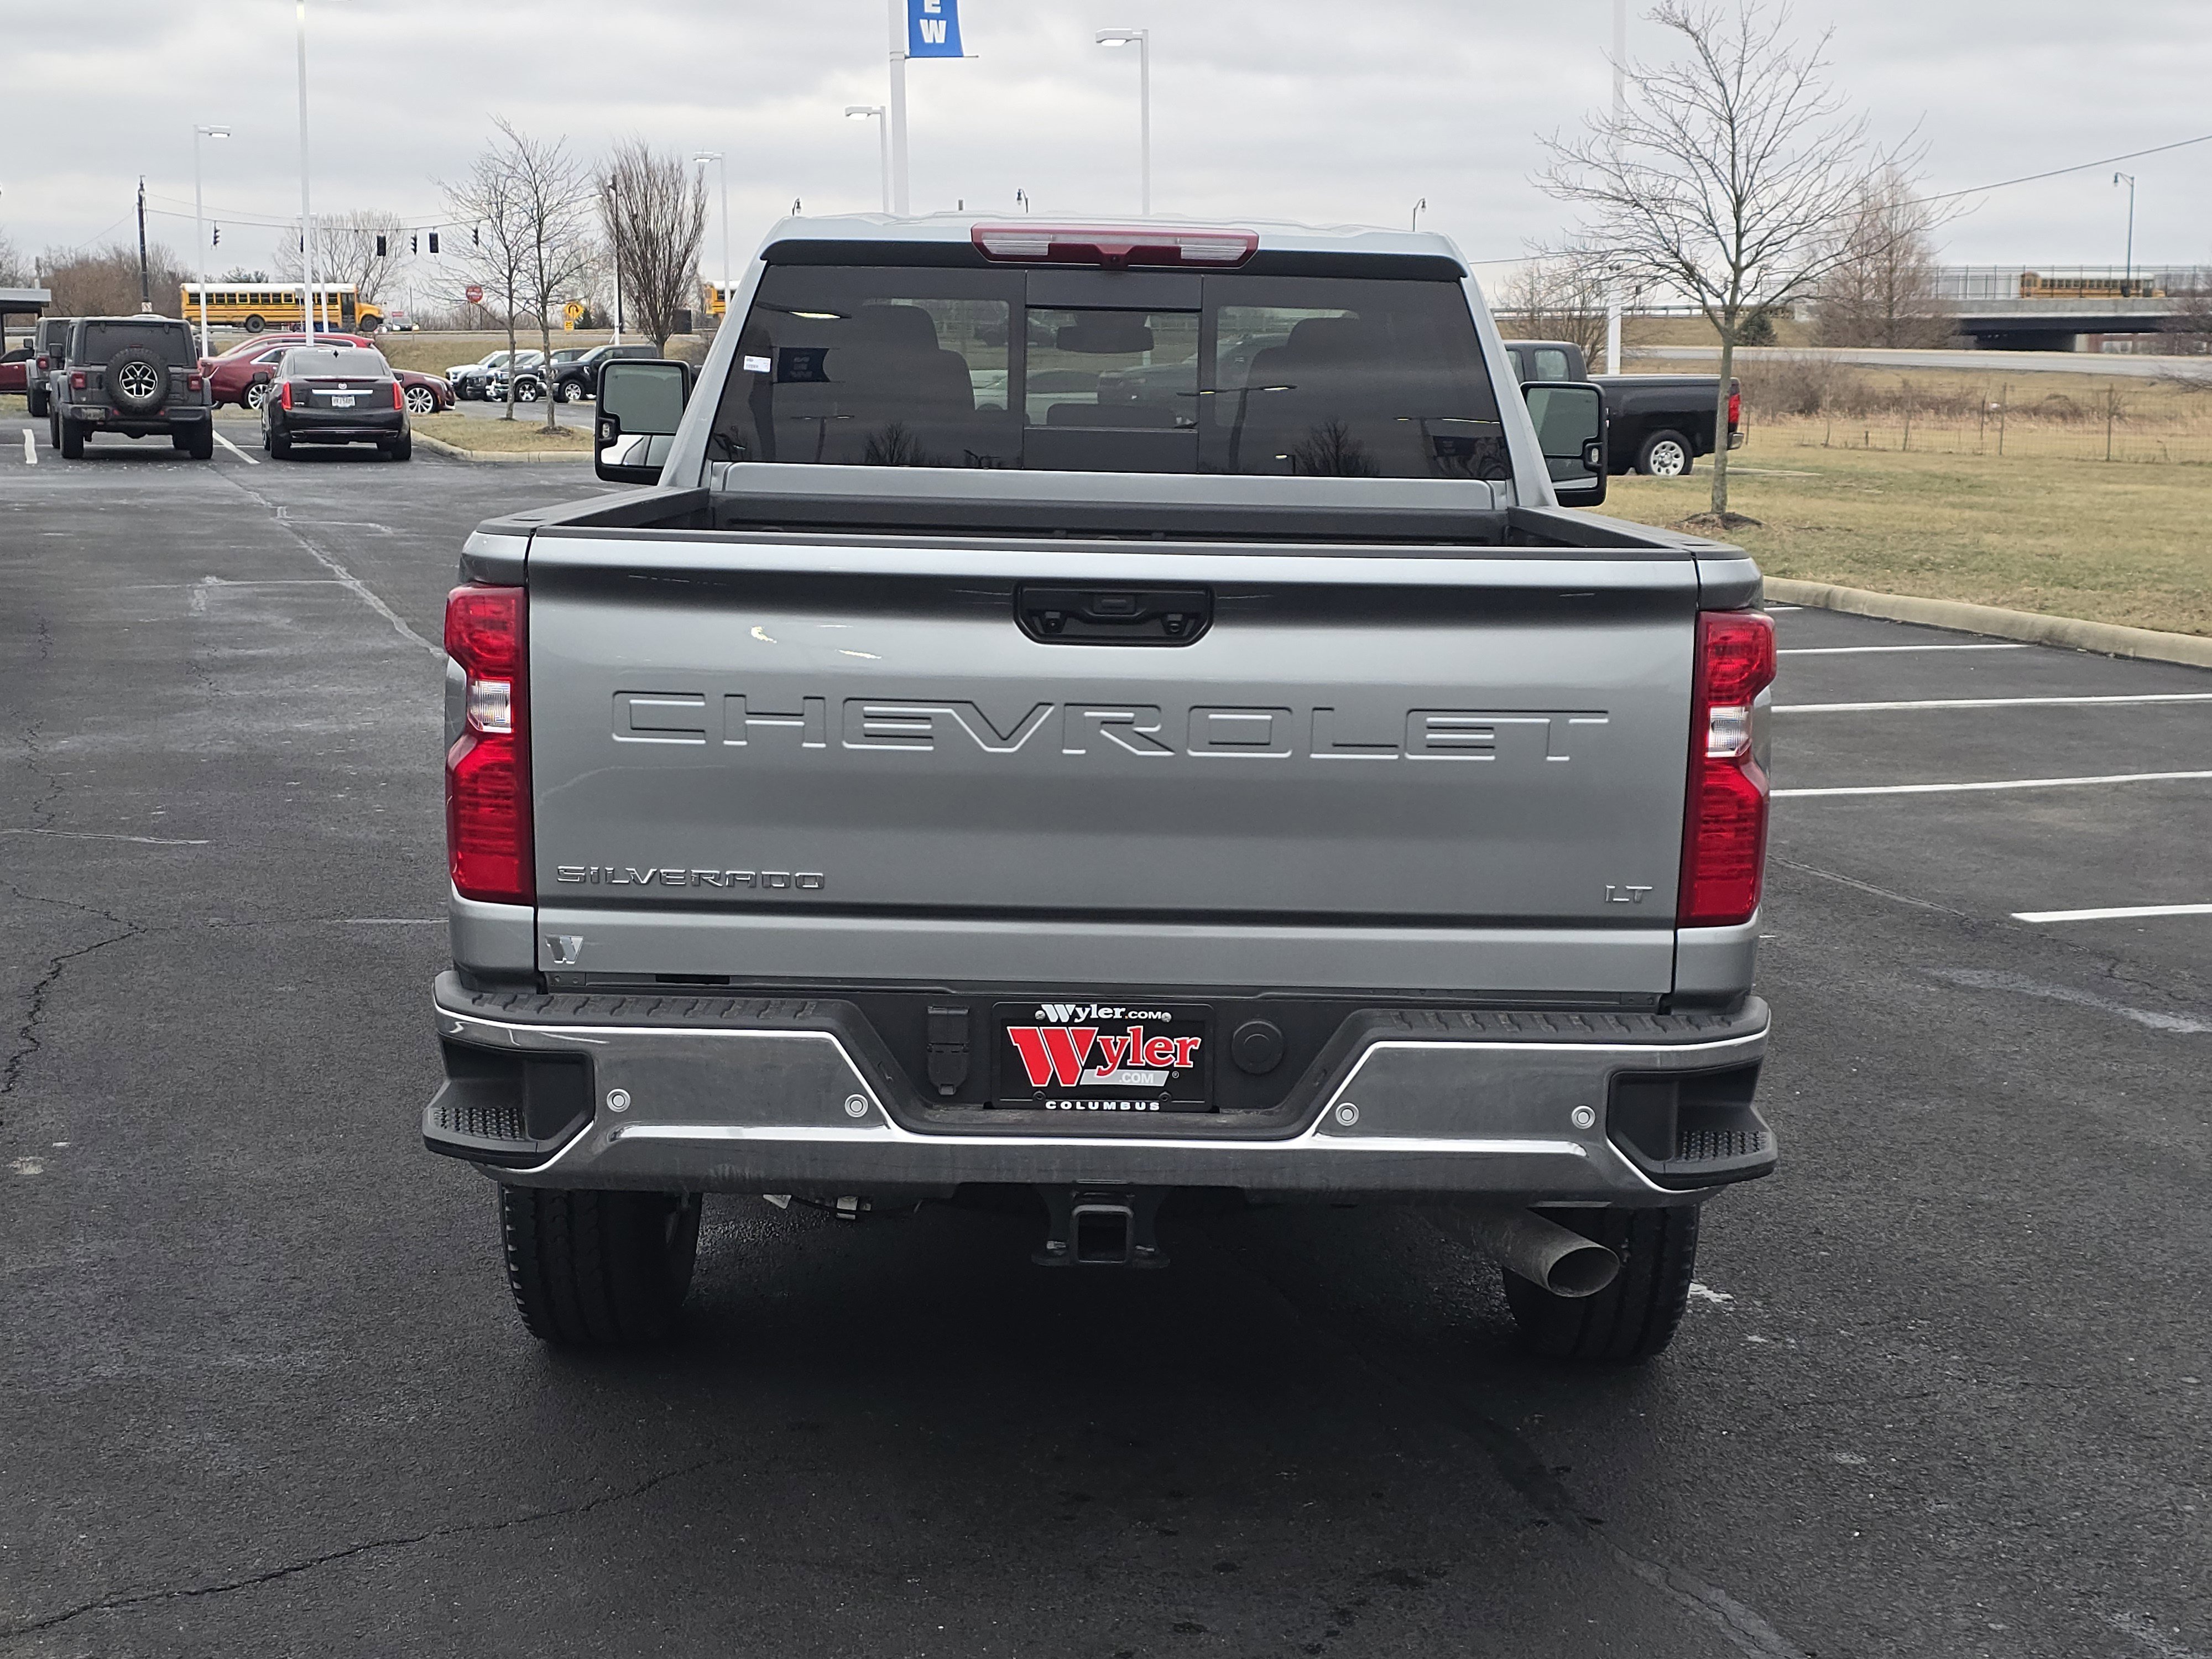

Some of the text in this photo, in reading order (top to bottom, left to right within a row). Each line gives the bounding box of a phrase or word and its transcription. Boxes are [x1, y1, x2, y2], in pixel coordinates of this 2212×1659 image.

[612, 690, 1609, 762] CHEVROLET
[556, 865, 825, 889] SILVERADO
[1605, 884, 1653, 904] LT
[1006, 1025, 1202, 1087] Wyler
[1045, 1100, 1160, 1111] COLUMBUS
